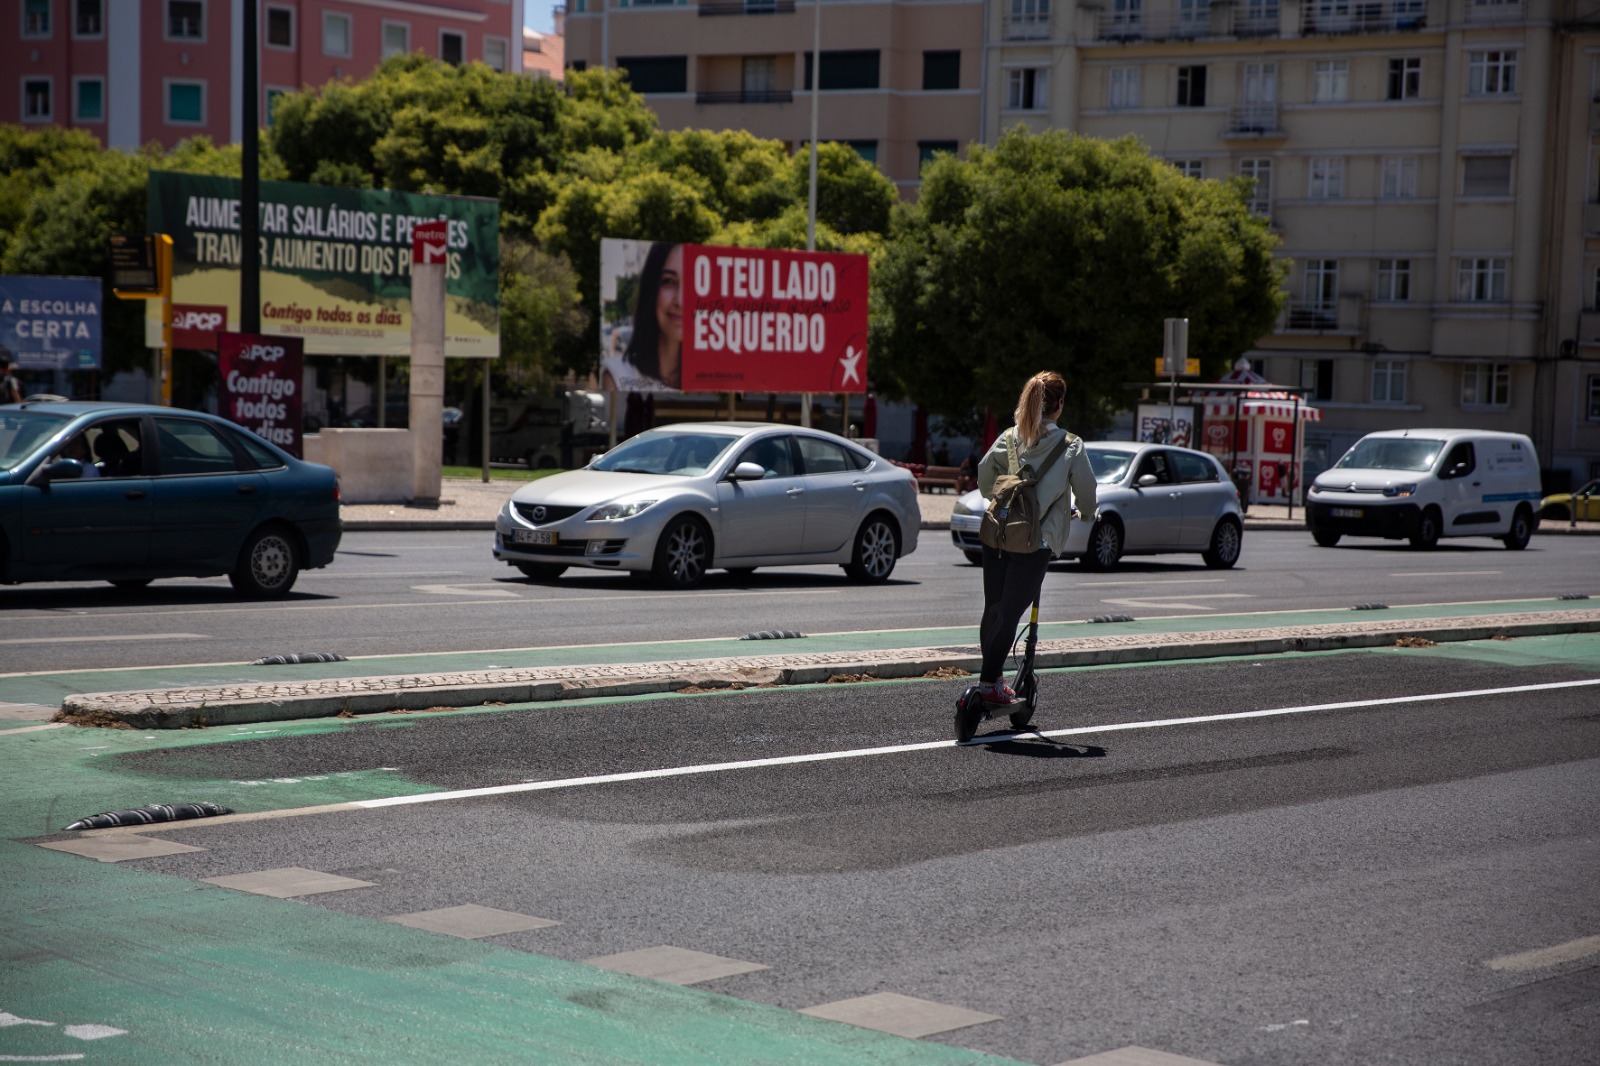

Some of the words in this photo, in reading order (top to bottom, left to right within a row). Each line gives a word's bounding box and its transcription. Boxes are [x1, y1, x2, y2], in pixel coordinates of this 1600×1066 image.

[185, 196, 288, 233] AUMETAR
[292, 203, 377, 241] SALÁRIOS
[381, 213, 392, 242] E
[415, 230, 445, 240] metro
[193, 231, 268, 265] TRAVR
[272, 237, 357, 272] AUMENTO
[360, 244, 394, 275] DOS
[694, 254, 711, 297] O
[716, 256, 764, 298] TEU
[772, 259, 836, 302] LADO
[2, 299, 14, 314] A
[20, 299, 98, 316] ESCOLHA
[262, 301, 312, 324] Contigo
[316, 304, 353, 323] todos
[357, 311, 371, 325] os
[375, 308, 402, 326] dias
[15, 319, 91, 339] CERTA
[185, 311, 223, 331] PCP
[694, 309, 825, 354] ESQUERDO
[250, 344, 285, 362] PCP
[226, 370, 296, 400] Contigo
[235, 395, 286, 420] todos
